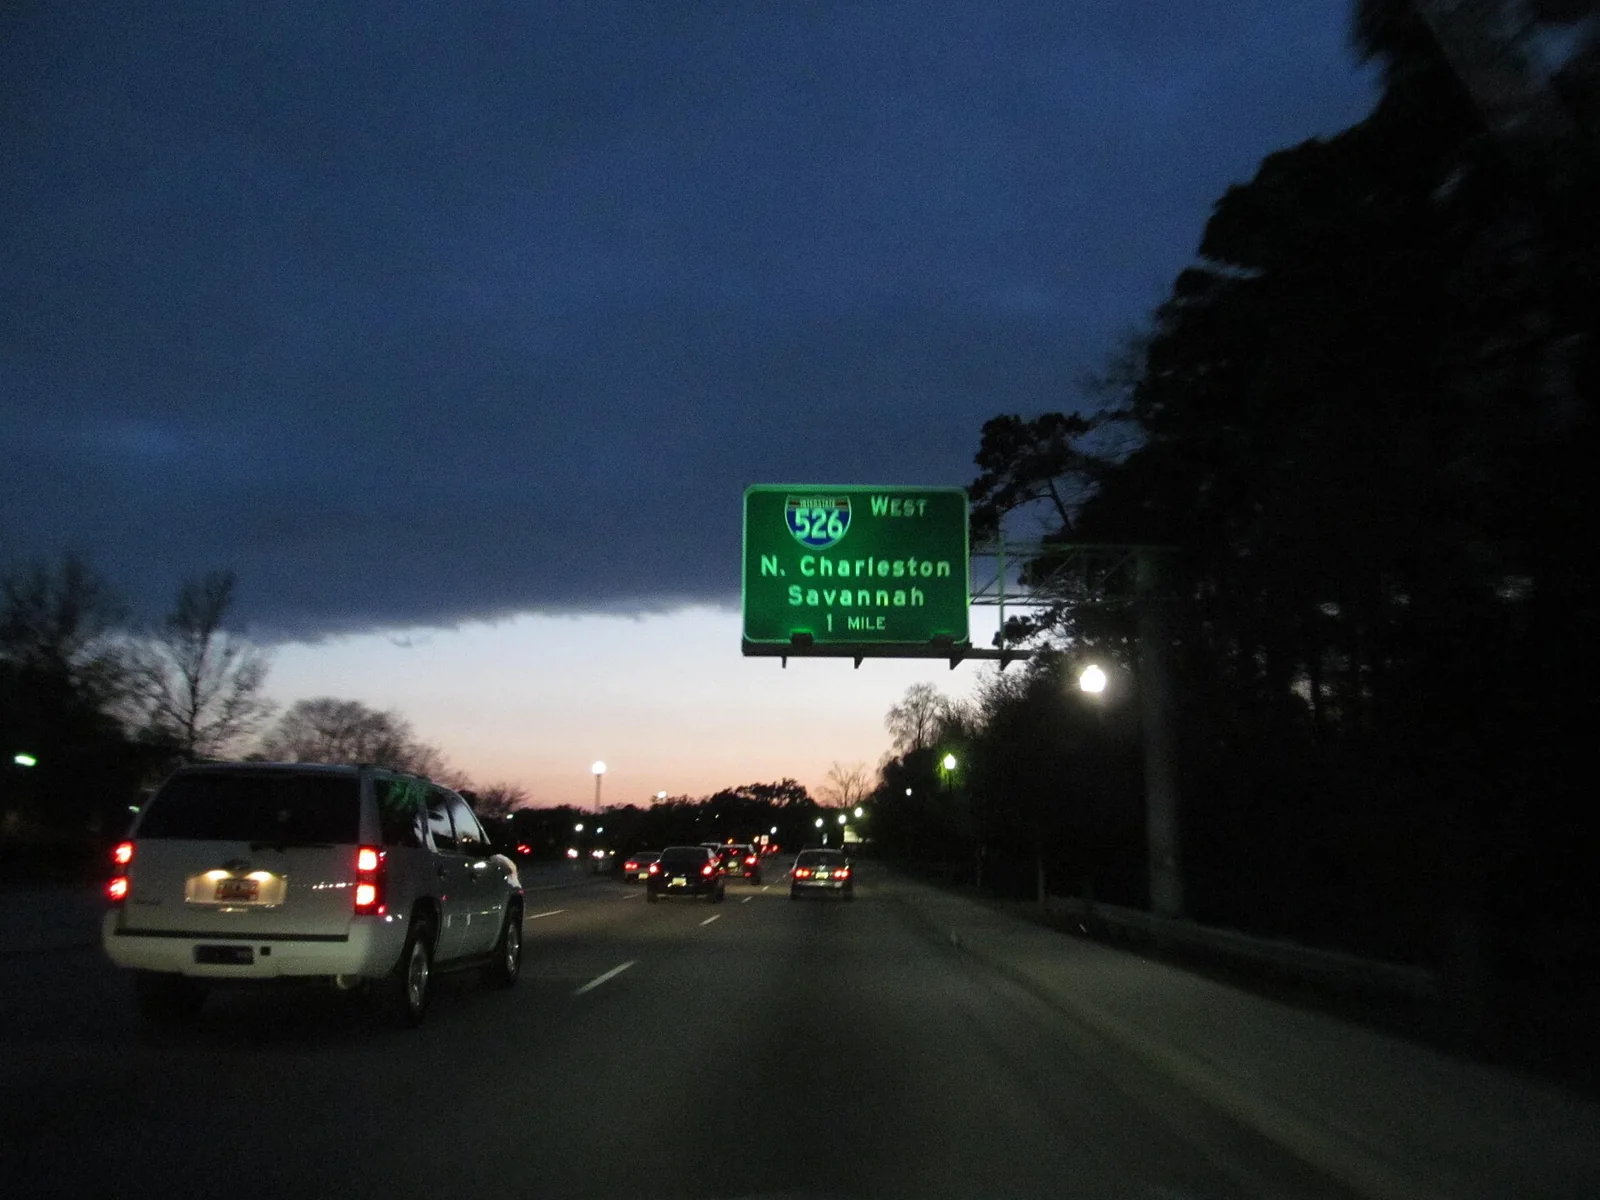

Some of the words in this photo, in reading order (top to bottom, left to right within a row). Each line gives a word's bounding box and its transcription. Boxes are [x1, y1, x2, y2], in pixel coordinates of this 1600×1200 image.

[870, 495, 927, 517] WEST
[795, 508, 843, 539] 526
[761, 554, 786, 577] N.
[799, 555, 951, 577] Charleston
[788, 584, 924, 606] Savannah
[826, 613, 833, 632] 1
[847, 616, 886, 630] MILE
